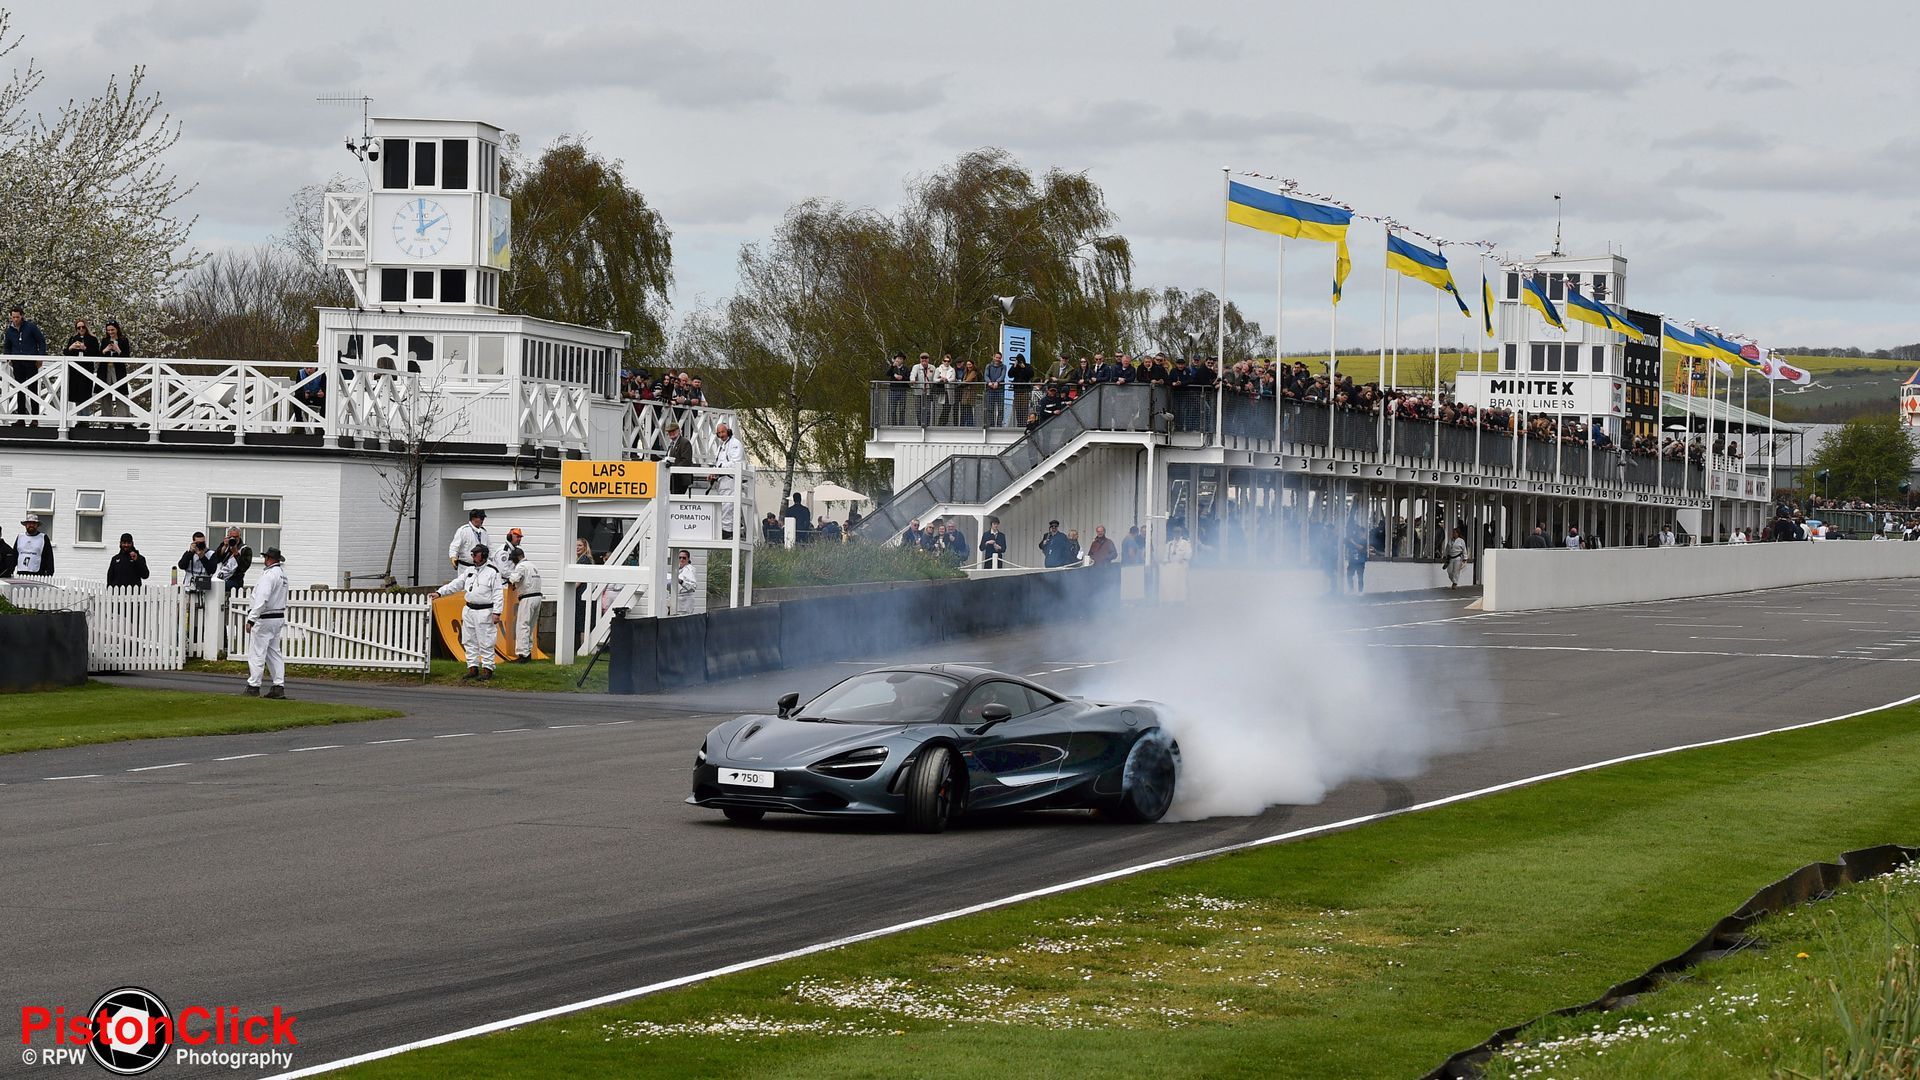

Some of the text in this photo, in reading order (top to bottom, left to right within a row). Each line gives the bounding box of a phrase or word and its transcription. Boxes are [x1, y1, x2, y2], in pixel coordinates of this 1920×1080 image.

[1490, 380, 1574, 395] MINTEX
[1490, 398, 1575, 409] BRAK LINERS
[1274, 456, 1281, 466] 2
[1301, 459, 1308, 469] 3
[592, 463, 625, 477] LAPS
[1326, 462, 1334, 472] 4
[1352, 464, 1358, 474] 5
[1376, 466, 1382, 476] 6
[1410, 470, 1416, 479] 7
[1432, 472, 1438, 482] 8
[1454, 474, 1460, 484] 9
[1468, 476, 1480, 486] 10
[1490, 478, 1499, 488] 11
[1506, 480, 1517, 489] 12
[569, 481, 648, 495] COMPLETED
[1533, 484, 1544, 492] 14
[1551, 486, 1561, 494] 15
[1566, 487, 1576, 495] 16
[1598, 490, 1608, 498] 18
[1613, 491, 1622, 499] 19
[1638, 494, 1648, 502] 20
